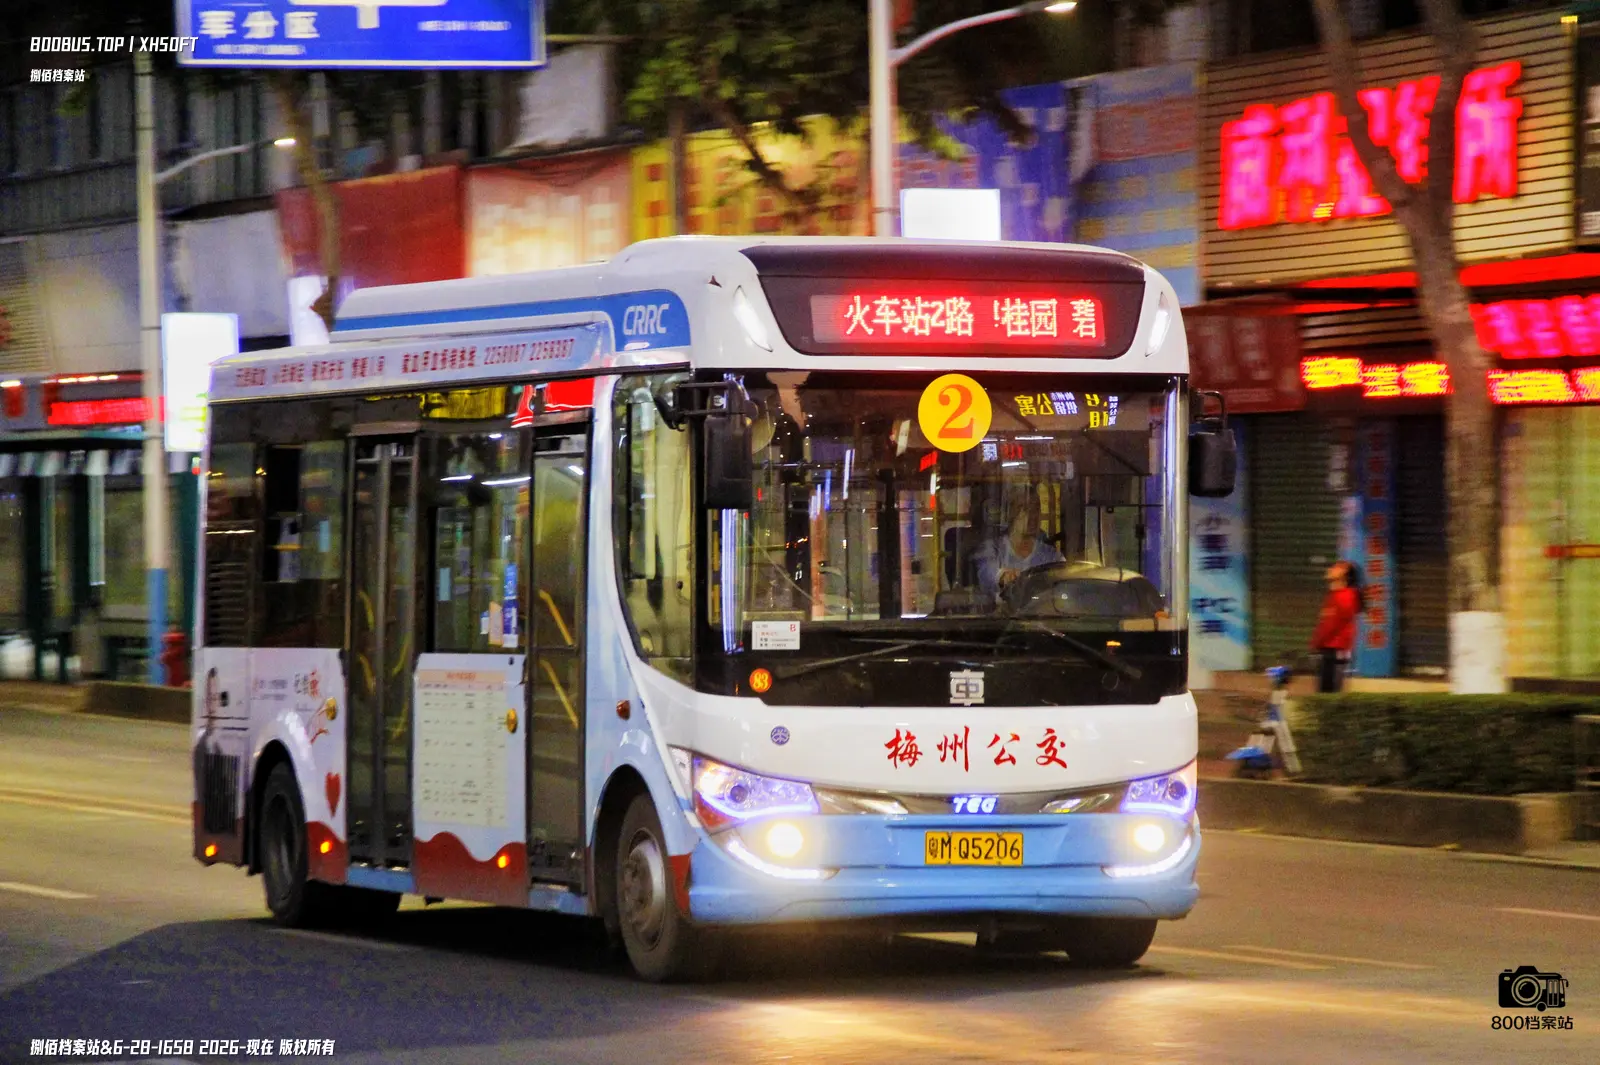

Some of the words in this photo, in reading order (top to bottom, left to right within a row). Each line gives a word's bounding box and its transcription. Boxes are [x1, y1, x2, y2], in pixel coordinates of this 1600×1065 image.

[623, 303, 670, 336] CRRC
[844, 295, 975, 336] 火车站2路
[937, 383, 975, 439] 2
[753, 671, 769, 690] 83
[884, 725, 1067, 773] 梅州公交
